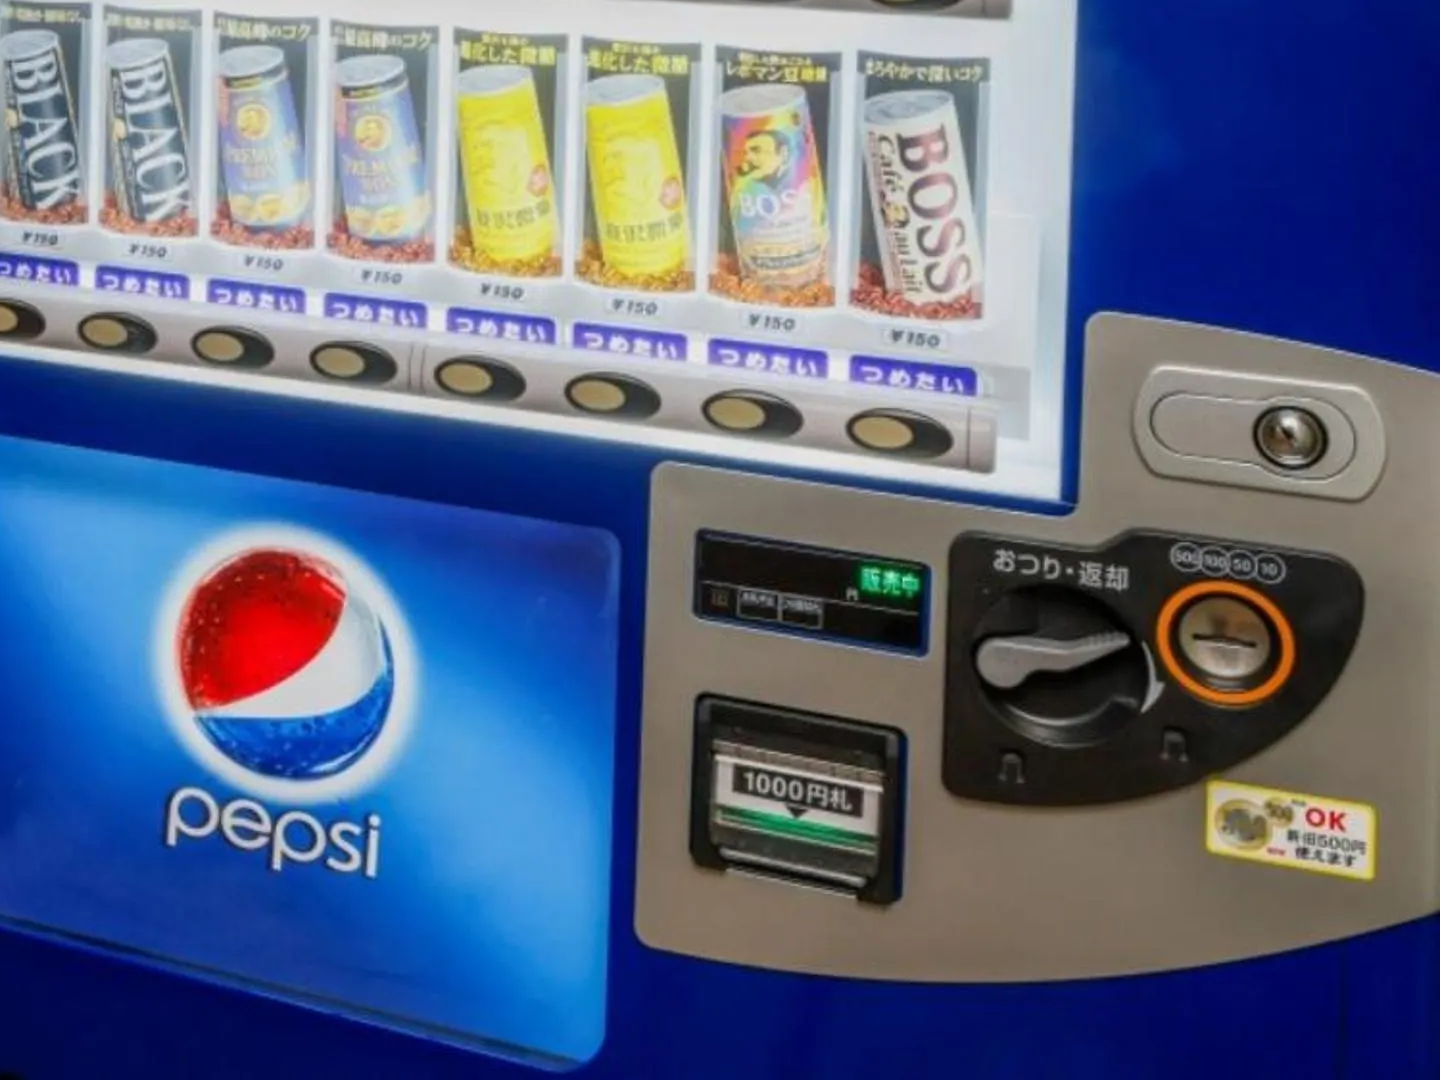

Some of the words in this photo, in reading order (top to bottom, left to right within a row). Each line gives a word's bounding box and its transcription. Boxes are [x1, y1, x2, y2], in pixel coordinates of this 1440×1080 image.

[11, 47, 79, 210] BLACK
[120, 57, 191, 222] BLACK
[897, 123, 972, 294] BOSS
[103, 275, 183, 298] つめたい
[215, 288, 298, 312] つめたい
[331, 302, 419, 326] つめたい
[613, 298, 658, 316] ¥150
[454, 315, 548, 342] つめたい
[747, 313, 796, 332] ¥150
[583, 333, 679, 360] つめたい
[890, 328, 941, 348] ¥150
[717, 348, 818, 377] つめたい
[860, 365, 965, 393] つめたい
[861, 566, 921, 598] 販売中
[993, 548, 1131, 592] おつり・返却
[742, 771, 853, 811] 1000円札
[165, 785, 382, 879] pepsi
[1304, 806, 1347, 833] OK
[1286, 829, 1368, 856] 新旧500円
[1295, 846, 1357, 868] 使えます
